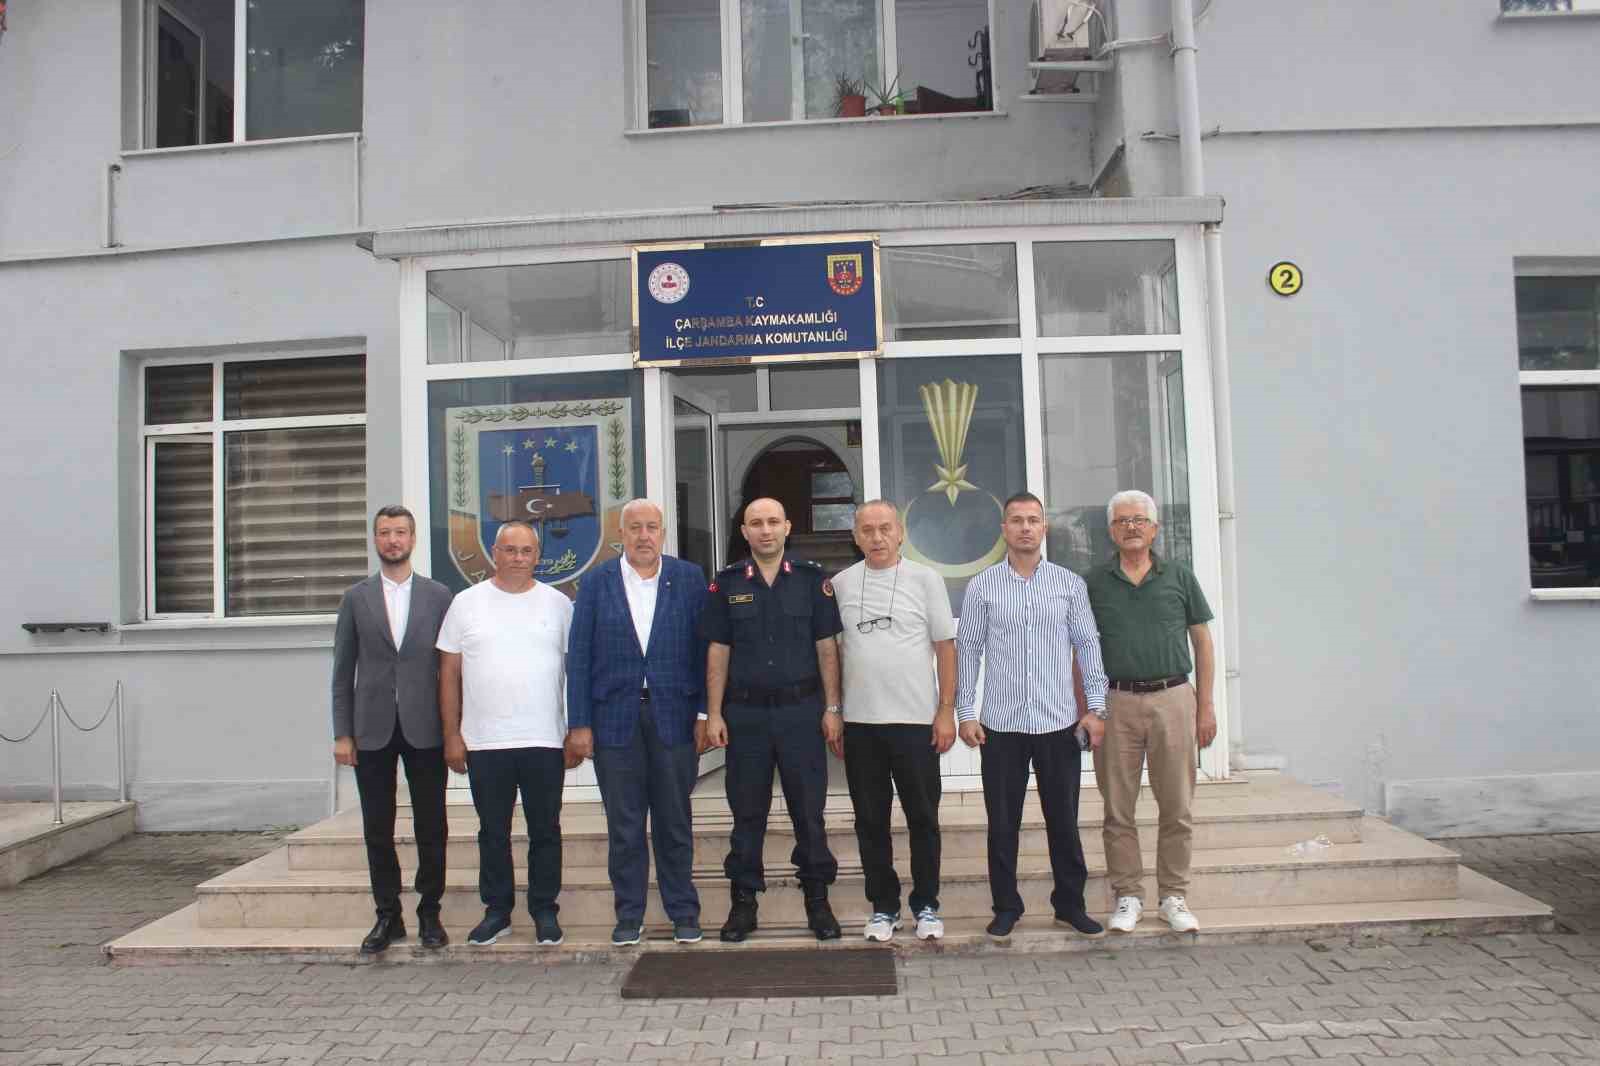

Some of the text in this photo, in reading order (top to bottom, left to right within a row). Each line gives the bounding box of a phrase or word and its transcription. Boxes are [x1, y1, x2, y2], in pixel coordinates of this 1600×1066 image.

[1280, 269, 1294, 288] 2
[675, 310, 837, 332] ÇARŞAMBA KAYMAKAMLIĞI
[665, 329, 848, 350] İLÇE JANDARMA KOMUTANLIĞI
